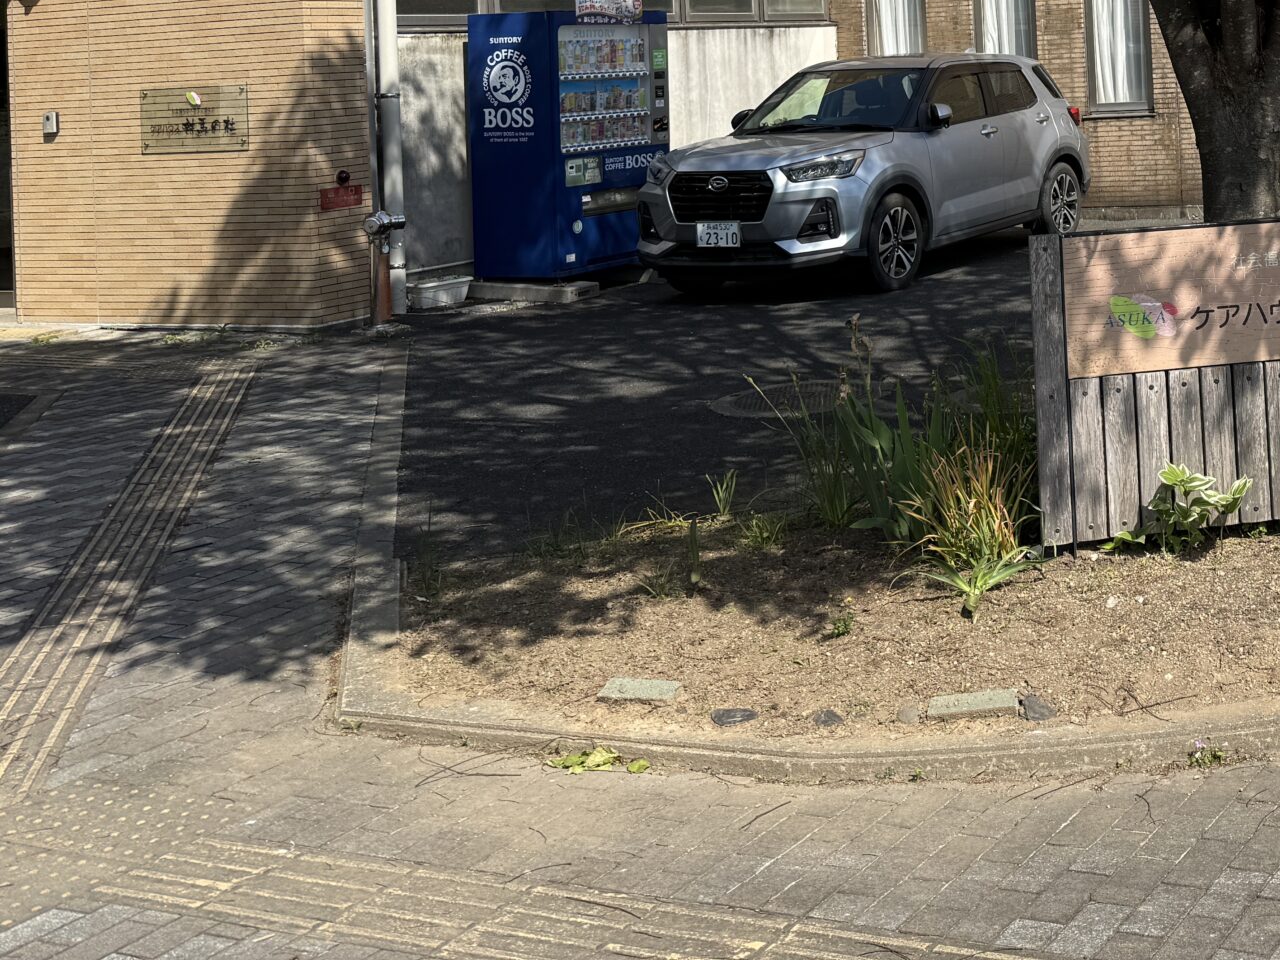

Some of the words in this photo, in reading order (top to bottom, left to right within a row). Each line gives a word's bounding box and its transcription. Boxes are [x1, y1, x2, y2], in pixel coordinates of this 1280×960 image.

[489, 36, 522, 44] SUNTORY
[574, 28, 616, 38] SUNTORY
[487, 49, 527, 66] COFFEE
[483, 107, 535, 128] BOSS
[605, 163, 625, 171] COFFEE
[625, 153, 654, 169] BOSS
[705, 232, 738, 245] 23-10
[1103, 310, 1166, 329] ASUKA
